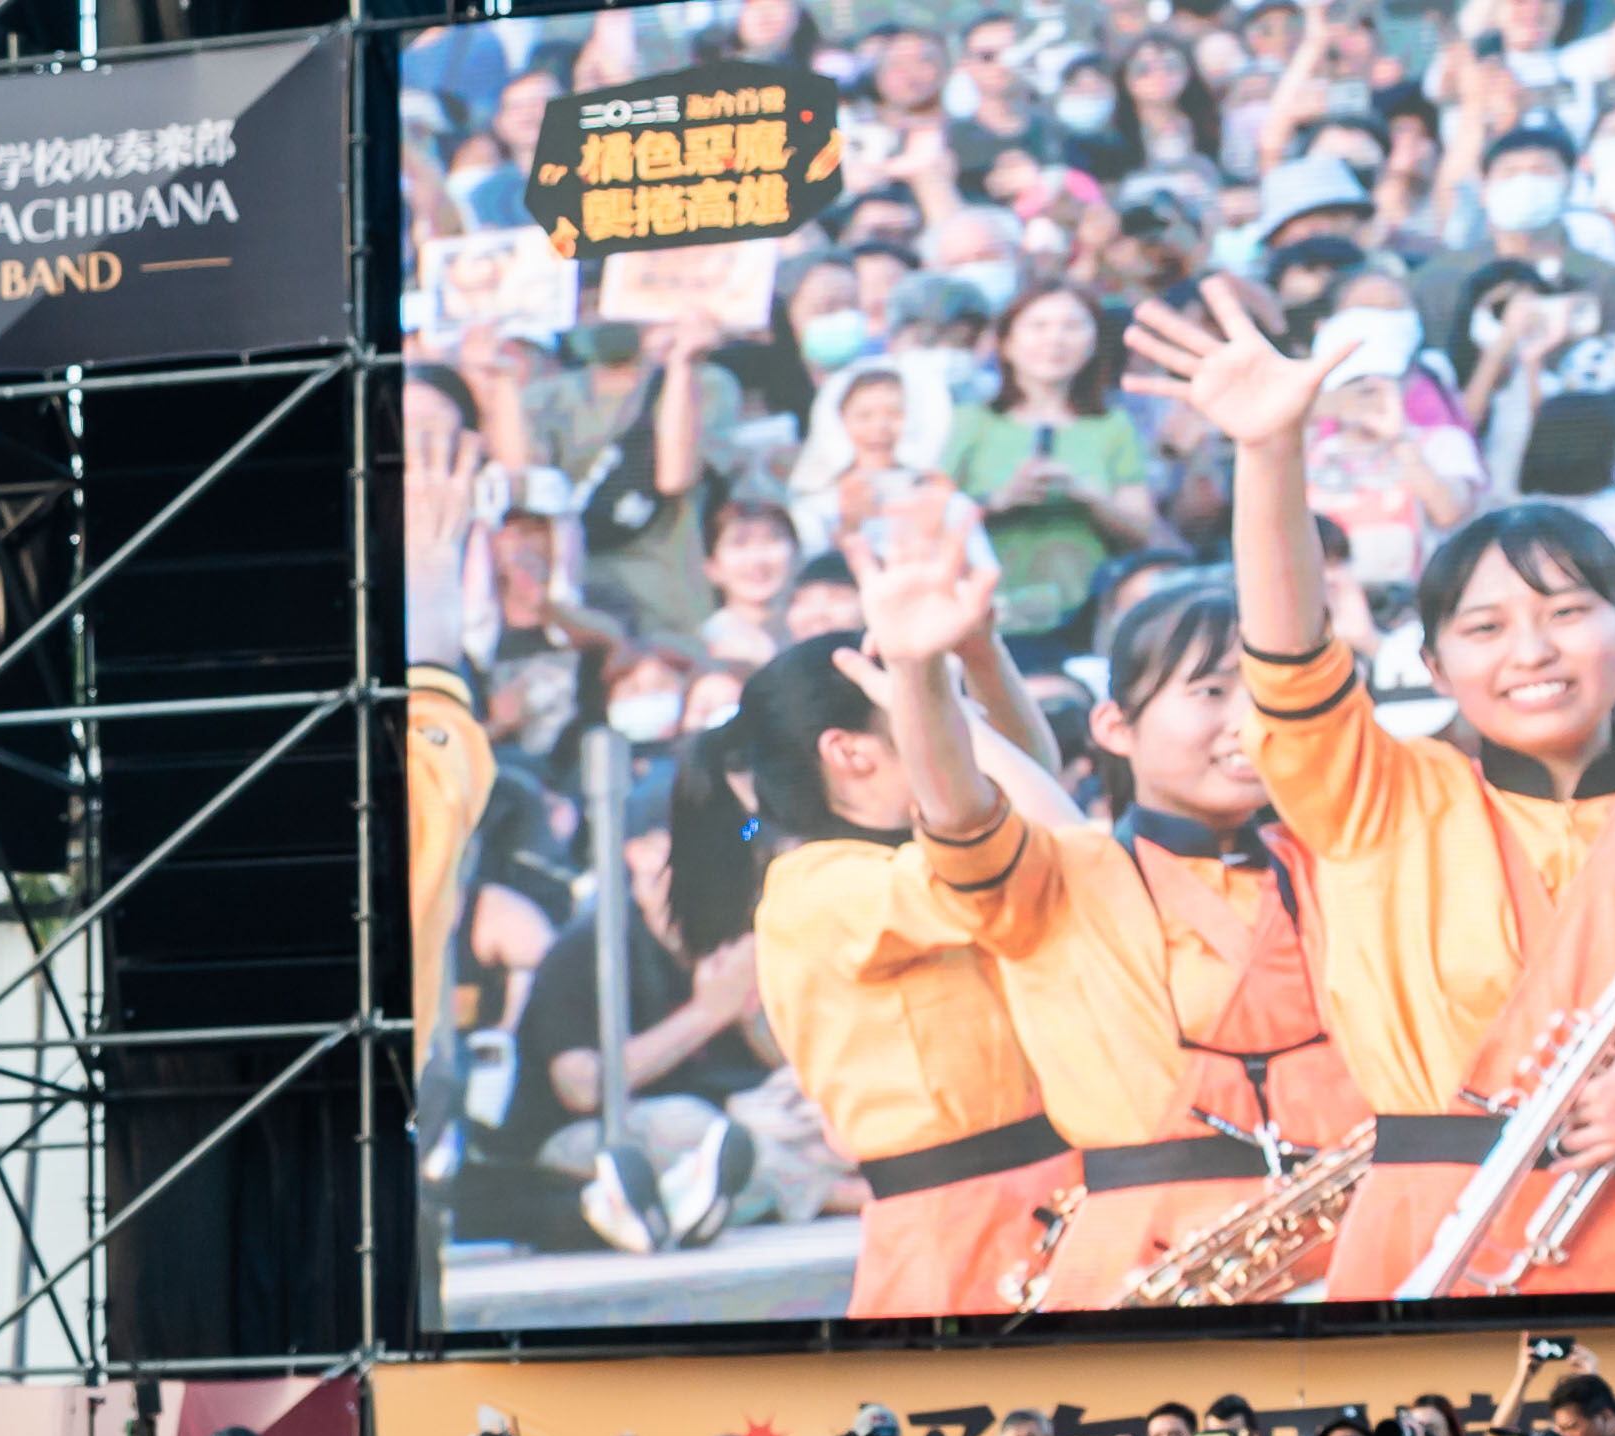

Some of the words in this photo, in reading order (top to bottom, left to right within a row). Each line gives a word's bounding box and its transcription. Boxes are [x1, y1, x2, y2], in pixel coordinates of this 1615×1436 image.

[577, 119, 789, 185] 橘色惡魔
[0, 251, 123, 300] BAND
